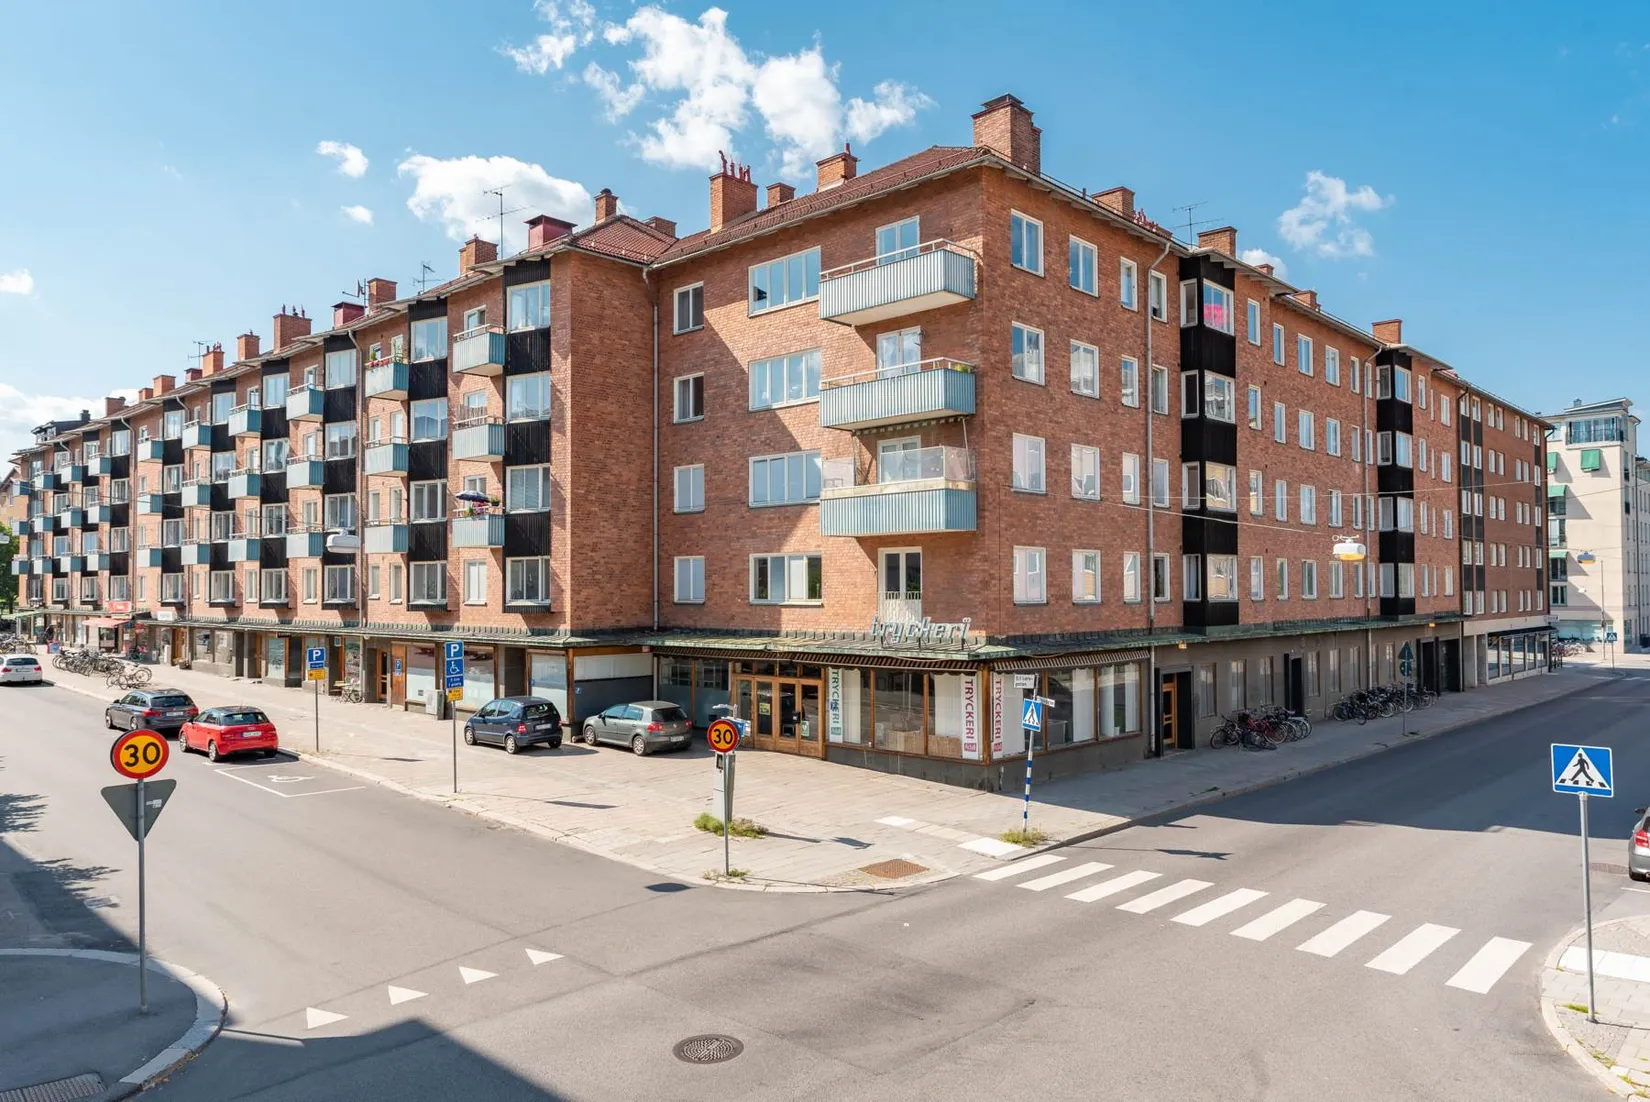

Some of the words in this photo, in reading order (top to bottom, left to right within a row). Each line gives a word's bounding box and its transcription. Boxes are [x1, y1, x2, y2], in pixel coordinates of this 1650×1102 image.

[312, 650, 321, 661] P
[451, 644, 460, 657] P
[964, 679, 975, 739] TRYCKERI
[713, 728, 733, 745] 30
[124, 741, 161, 768] 30
